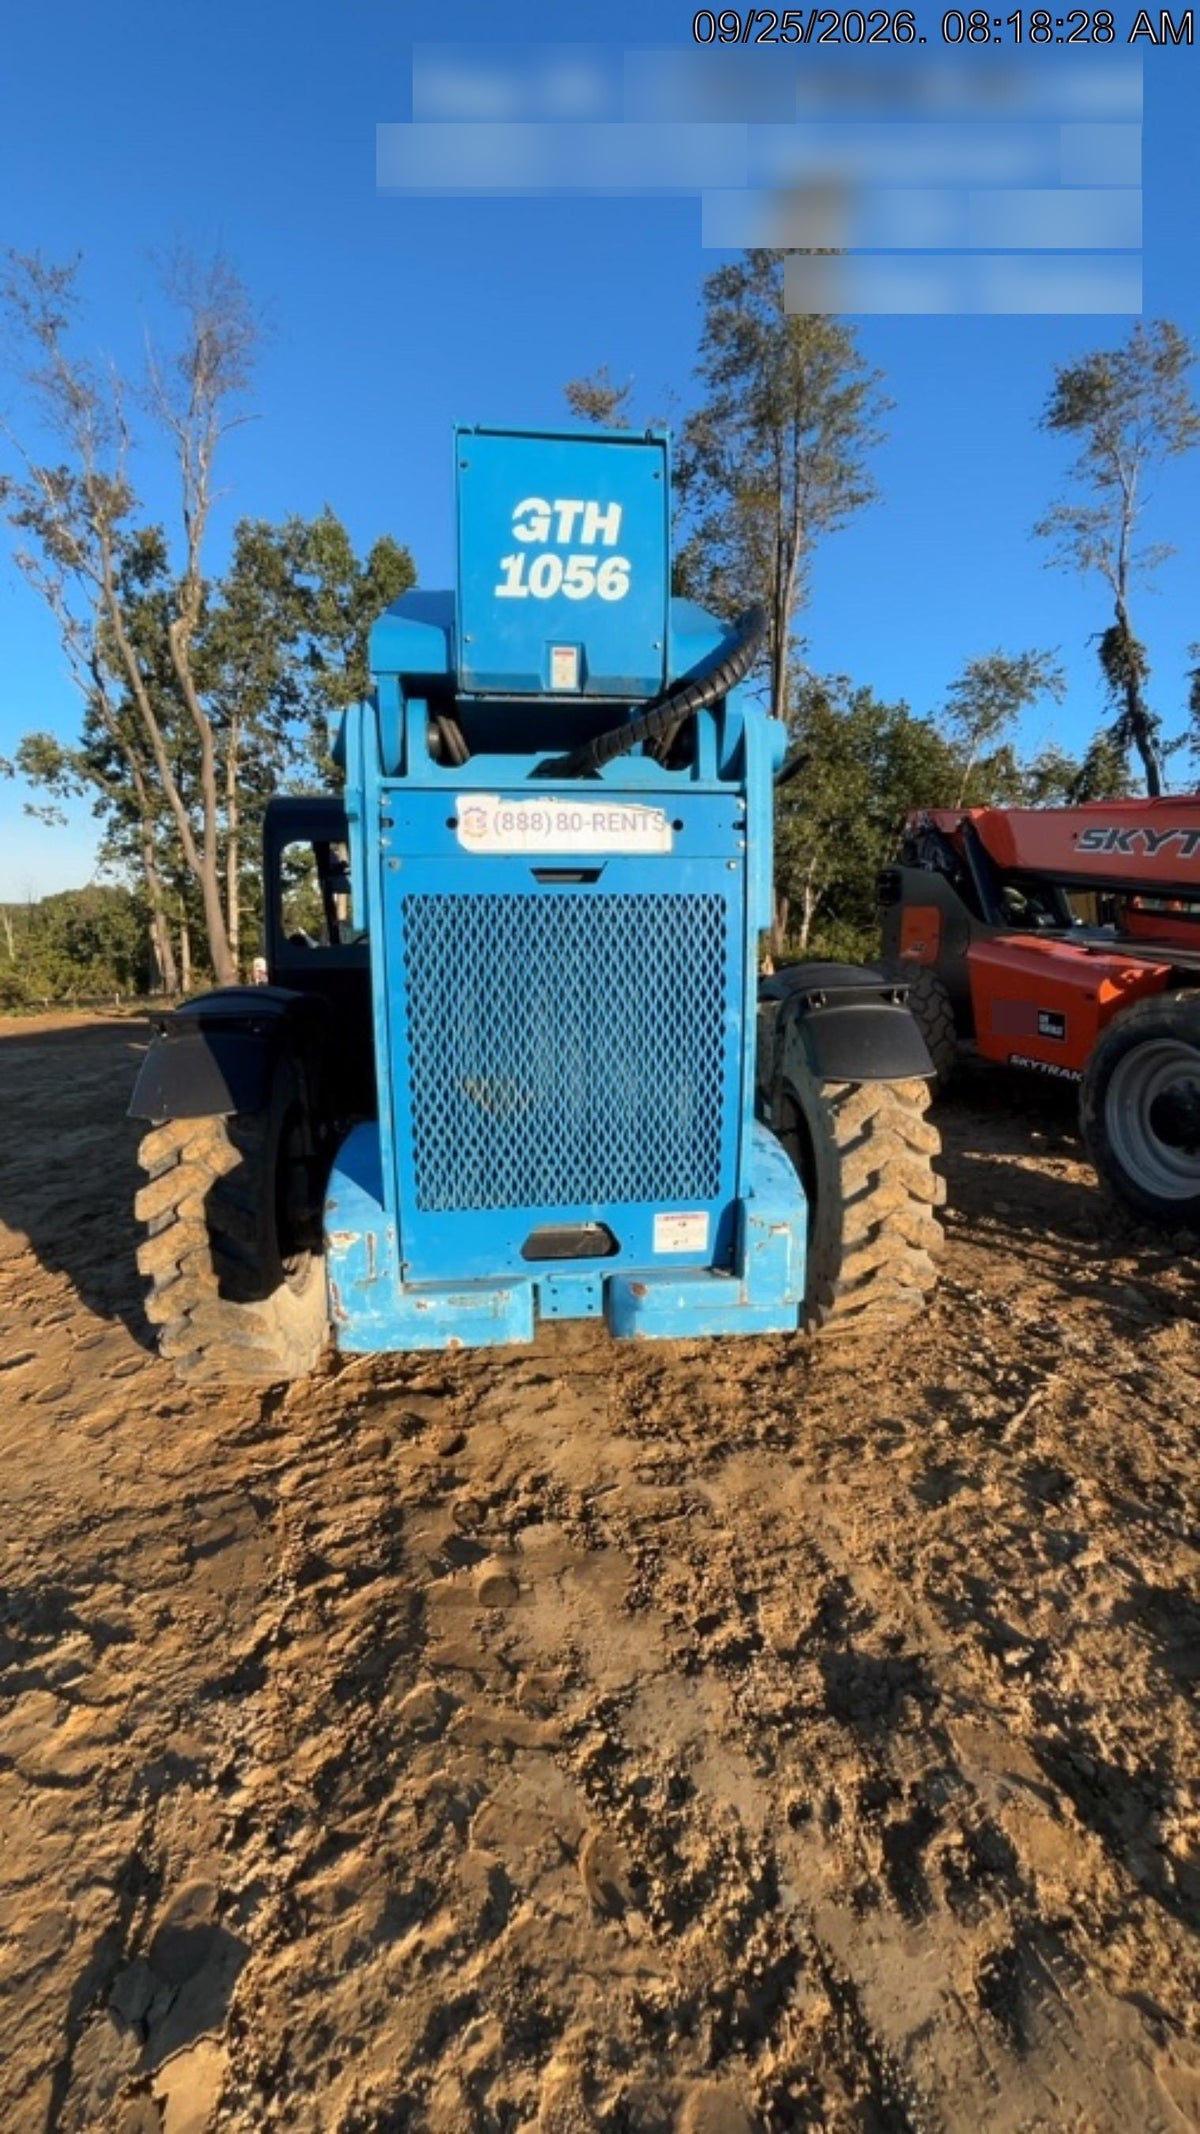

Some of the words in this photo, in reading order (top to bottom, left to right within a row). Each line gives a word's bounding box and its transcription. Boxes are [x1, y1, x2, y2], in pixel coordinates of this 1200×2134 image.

[511, 497, 622, 546] GTH
[494, 552, 632, 601] 1056
[1009, 1054, 1083, 1082] SKYTRAK
